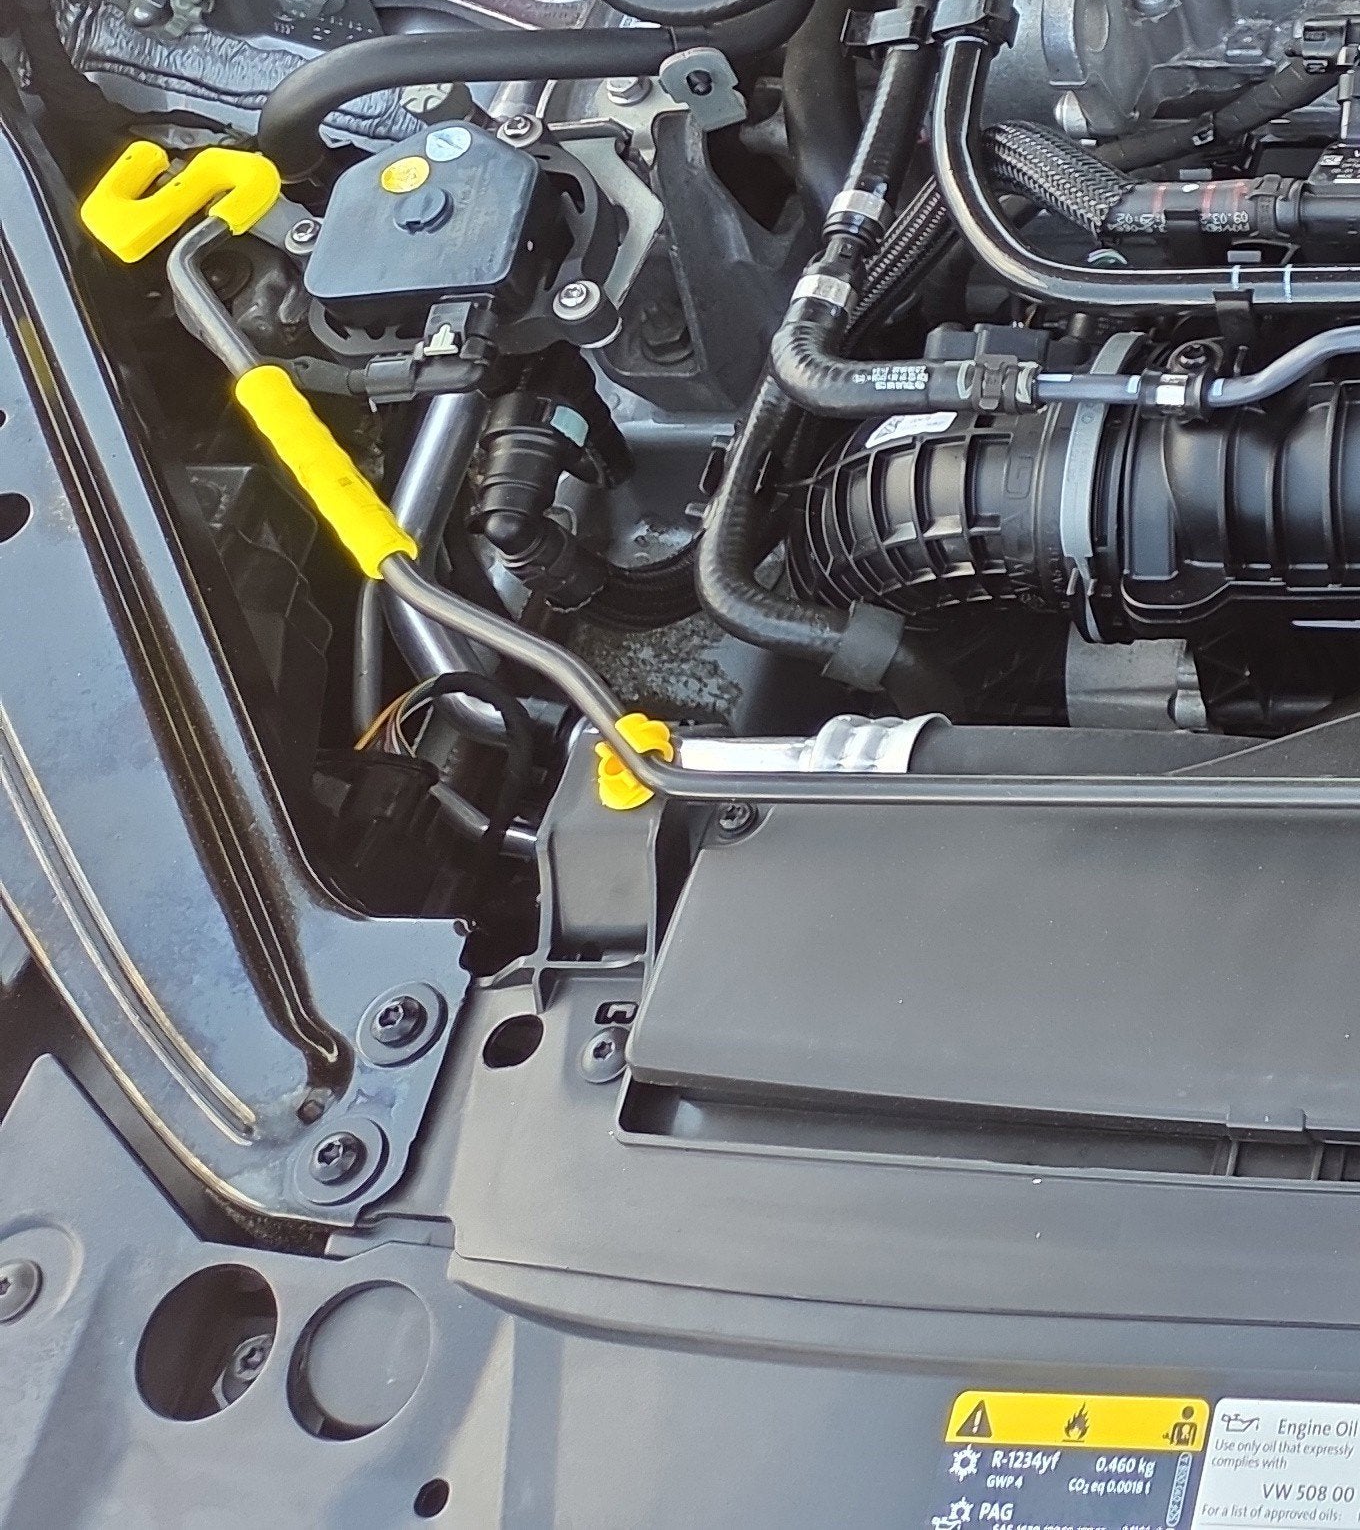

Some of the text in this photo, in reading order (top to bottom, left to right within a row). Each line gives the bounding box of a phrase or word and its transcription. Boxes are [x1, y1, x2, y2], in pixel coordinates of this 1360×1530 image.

[1278, 1418, 1359, 1441] Engine Oil
[1214, 1439, 1355, 1460] Use only oil that expressly
[991, 1450, 1156, 1479] R-1234yf 0.460 kg
[1211, 1456, 1288, 1470] complies with
[987, 1474, 1024, 1489] GWP 4
[1090, 1482, 1106, 1497] eq
[1262, 1482, 1294, 1501] VW
[1296, 1484, 1329, 1502] 508
[1331, 1485, 1356, 1503] 00
[978, 1501, 1015, 1522] PAG
[1201, 1504, 1222, 1517] For
[1222, 1506, 1229, 1517] a
[1230, 1505, 1248, 1518] list
[1249, 1505, 1264, 1518] of
[1265, 1507, 1316, 1524] approved
